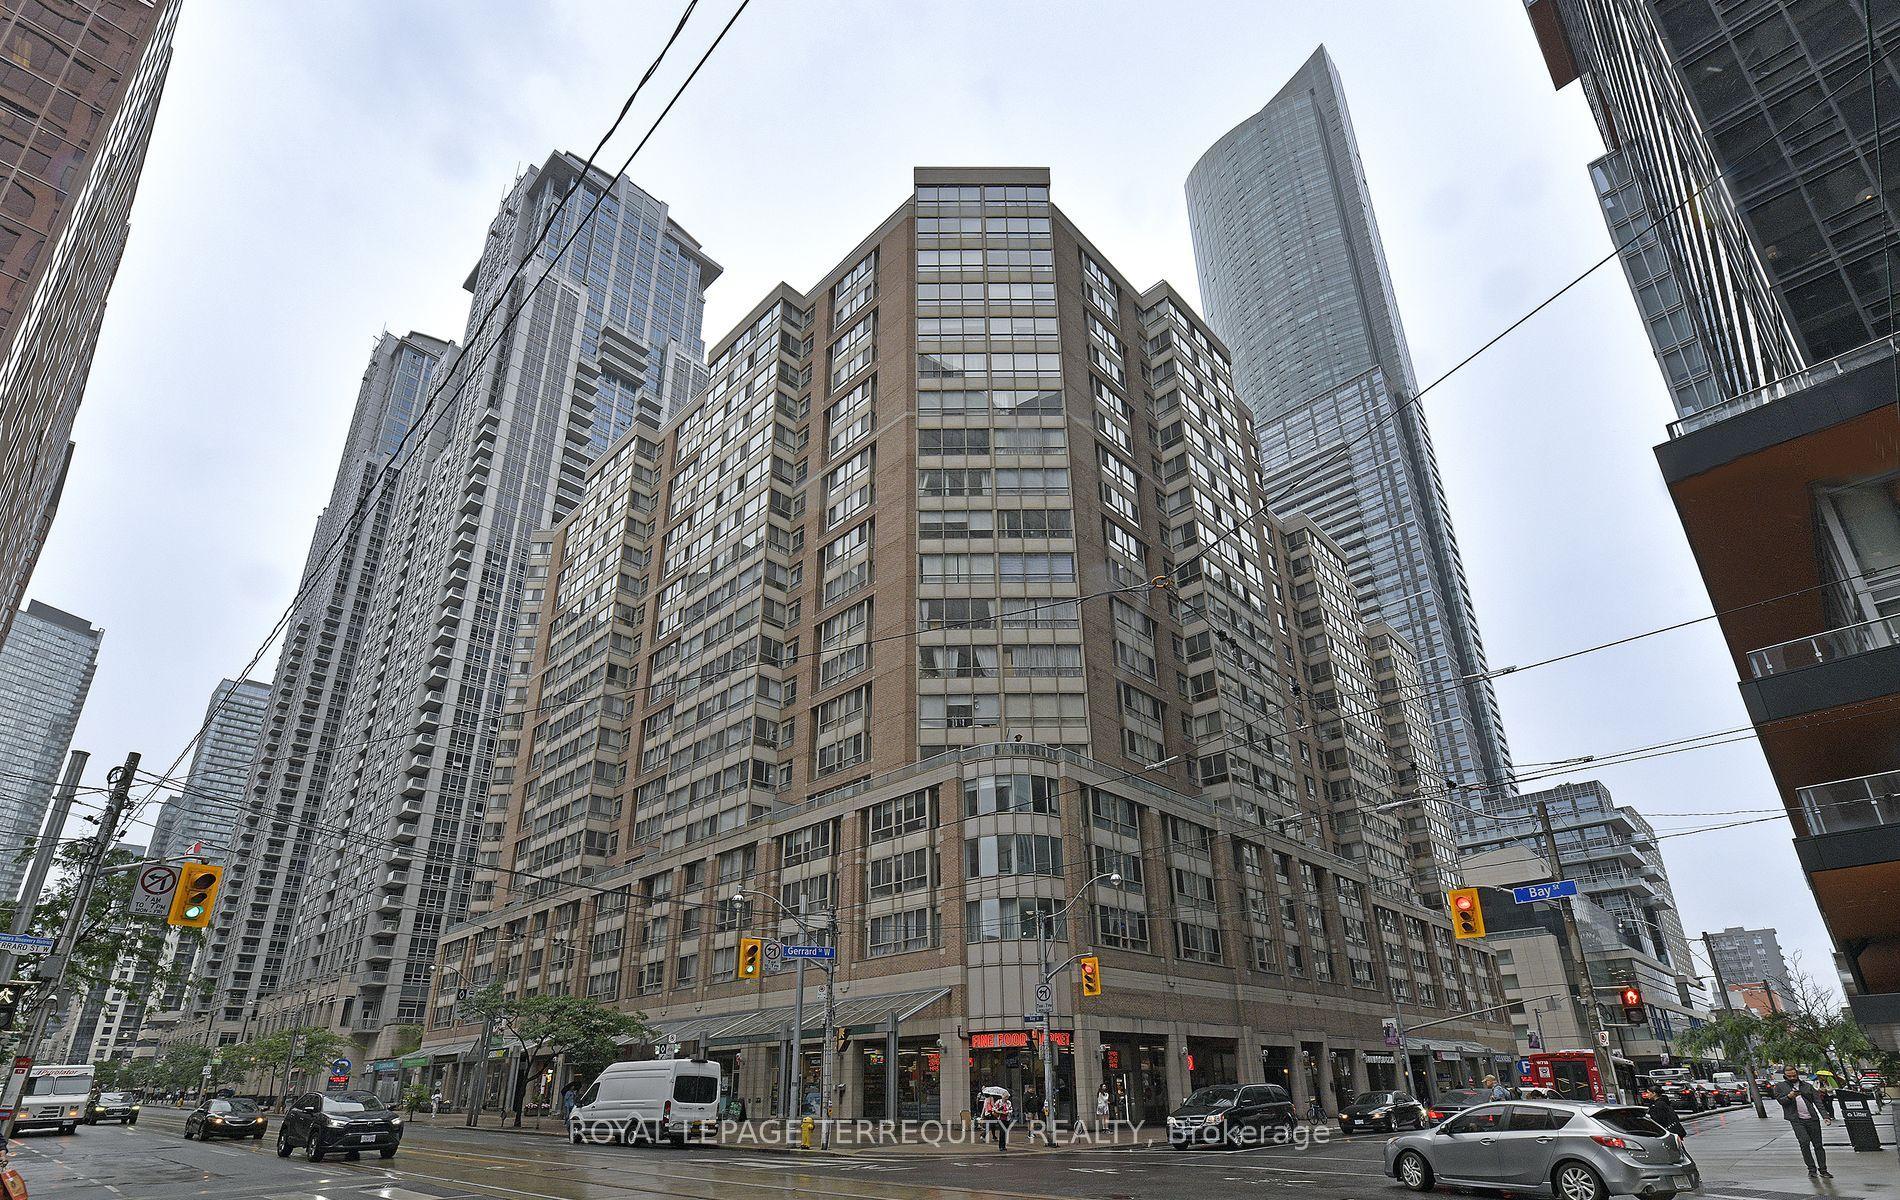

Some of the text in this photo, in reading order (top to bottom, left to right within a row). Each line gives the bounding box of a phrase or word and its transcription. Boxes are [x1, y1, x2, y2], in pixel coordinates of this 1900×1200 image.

[1529, 887, 1550, 898] Bay
[0, 941, 28, 950] RRARD
[787, 947, 817, 955] Gerrard
[824, 948, 831, 956] W
[972, 1034, 994, 1048] FINE
[997, 1033, 1028, 1046] FOOD
[41, 1068, 79, 1076] Purolator
